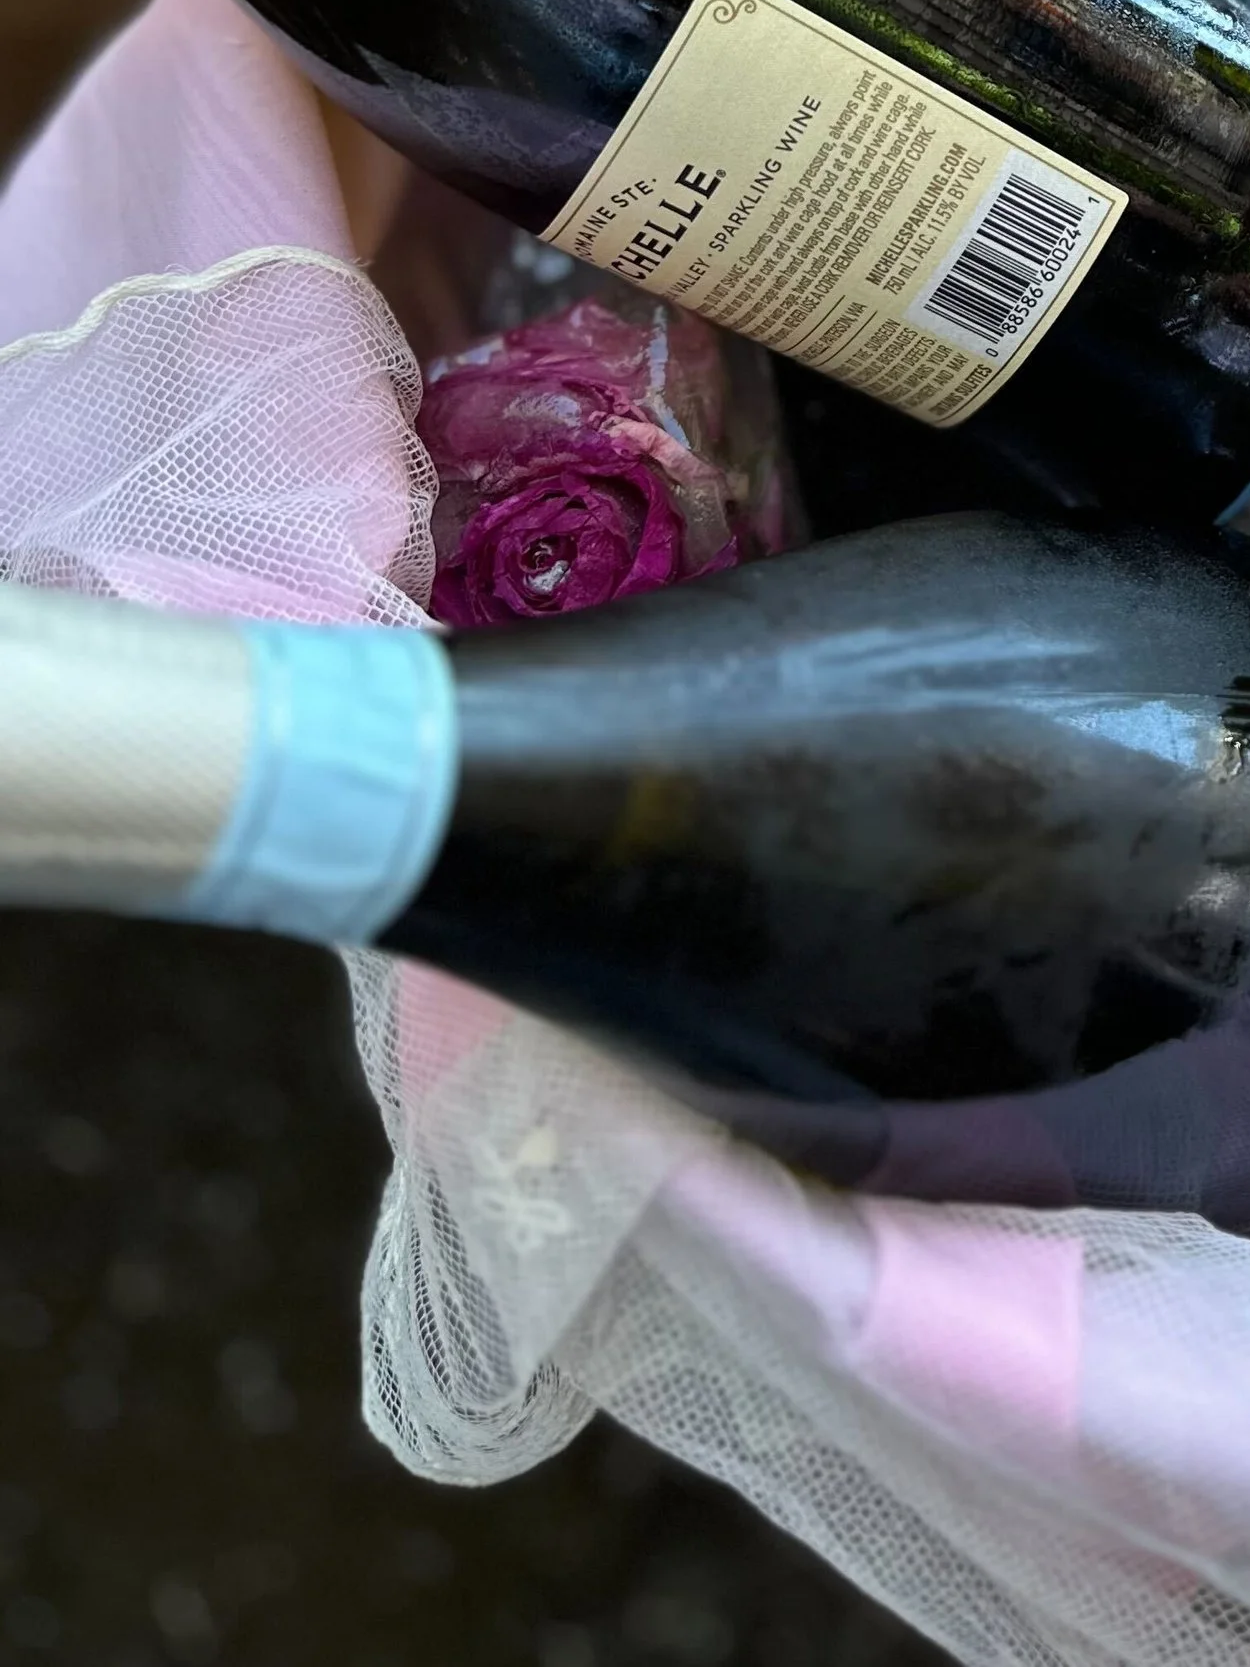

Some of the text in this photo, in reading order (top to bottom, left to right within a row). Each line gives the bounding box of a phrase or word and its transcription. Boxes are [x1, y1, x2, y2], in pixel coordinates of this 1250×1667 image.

[867, 80, 894, 111] while
[884, 93, 910, 123] cage.
[847, 111, 875, 145] times
[869, 121, 893, 146] wire
[839, 141, 856, 159] all
[856, 144, 878, 170] and
[738, 230, 774, 267] Contents
[764, 206, 791, 235] under
[779, 187, 806, 209] high
[797, 140, 837, 189] pressure,
[828, 98, 860, 140] always
[851, 69, 877, 102] point
[831, 157, 847, 173] at
[957, 156, 986, 180] VOL.
[669, 256, 710, 290] VALLEY
[708, 156, 783, 253] SPARKLING
[774, 94, 822, 152] WINE
[802, 253, 830, 278] bottle
[820, 234, 844, 256] from
[833, 210, 861, 236] base
[853, 187, 875, 212] with
[868, 160, 892, 190] other
[881, 130, 910, 162] hand
[901, 100, 927, 132] while
[811, 169, 839, 199] hood
[842, 166, 866, 192] cork
[872, 158, 916, 215] REINSERT
[946, 177, 969, 200] BY
[834, 186, 851, 203] of
[798, 196, 821, 223] cage
[823, 199, 845, 218] top
[862, 210, 883, 230] OR
[864, 142, 968, 286] MICHELLESPARKLING.COM
[927, 198, 959, 232] 11.5%
[782, 221, 804, 242] wire
[816, 215, 834, 231] on
[771, 240, 791, 259] and
[795, 227, 825, 259] always
[830, 225, 873, 274] REMOVER
[910, 233, 937, 259] ALC.
[759, 257, 779, 275] cork
[778, 254, 804, 277] hand
[897, 262, 917, 279] mL
[984, 196, 1100, 357] 0 88586 60024 1
[814, 268, 842, 295] CORK
[882, 275, 906, 296] 750
[797, 294, 820, 313] USE
[809, 290, 825, 301] A
[844, 299, 867, 318] WA
[851, 347, 873, 361] THE
[863, 318, 901, 353] SURGEON
[875, 326, 919, 367] BEVERAGES
[900, 335, 938, 367] DEFECTS.
[925, 343, 953, 366] YOUR
[945, 351, 969, 372] MAY
[954, 362, 993, 397] SULFITES
